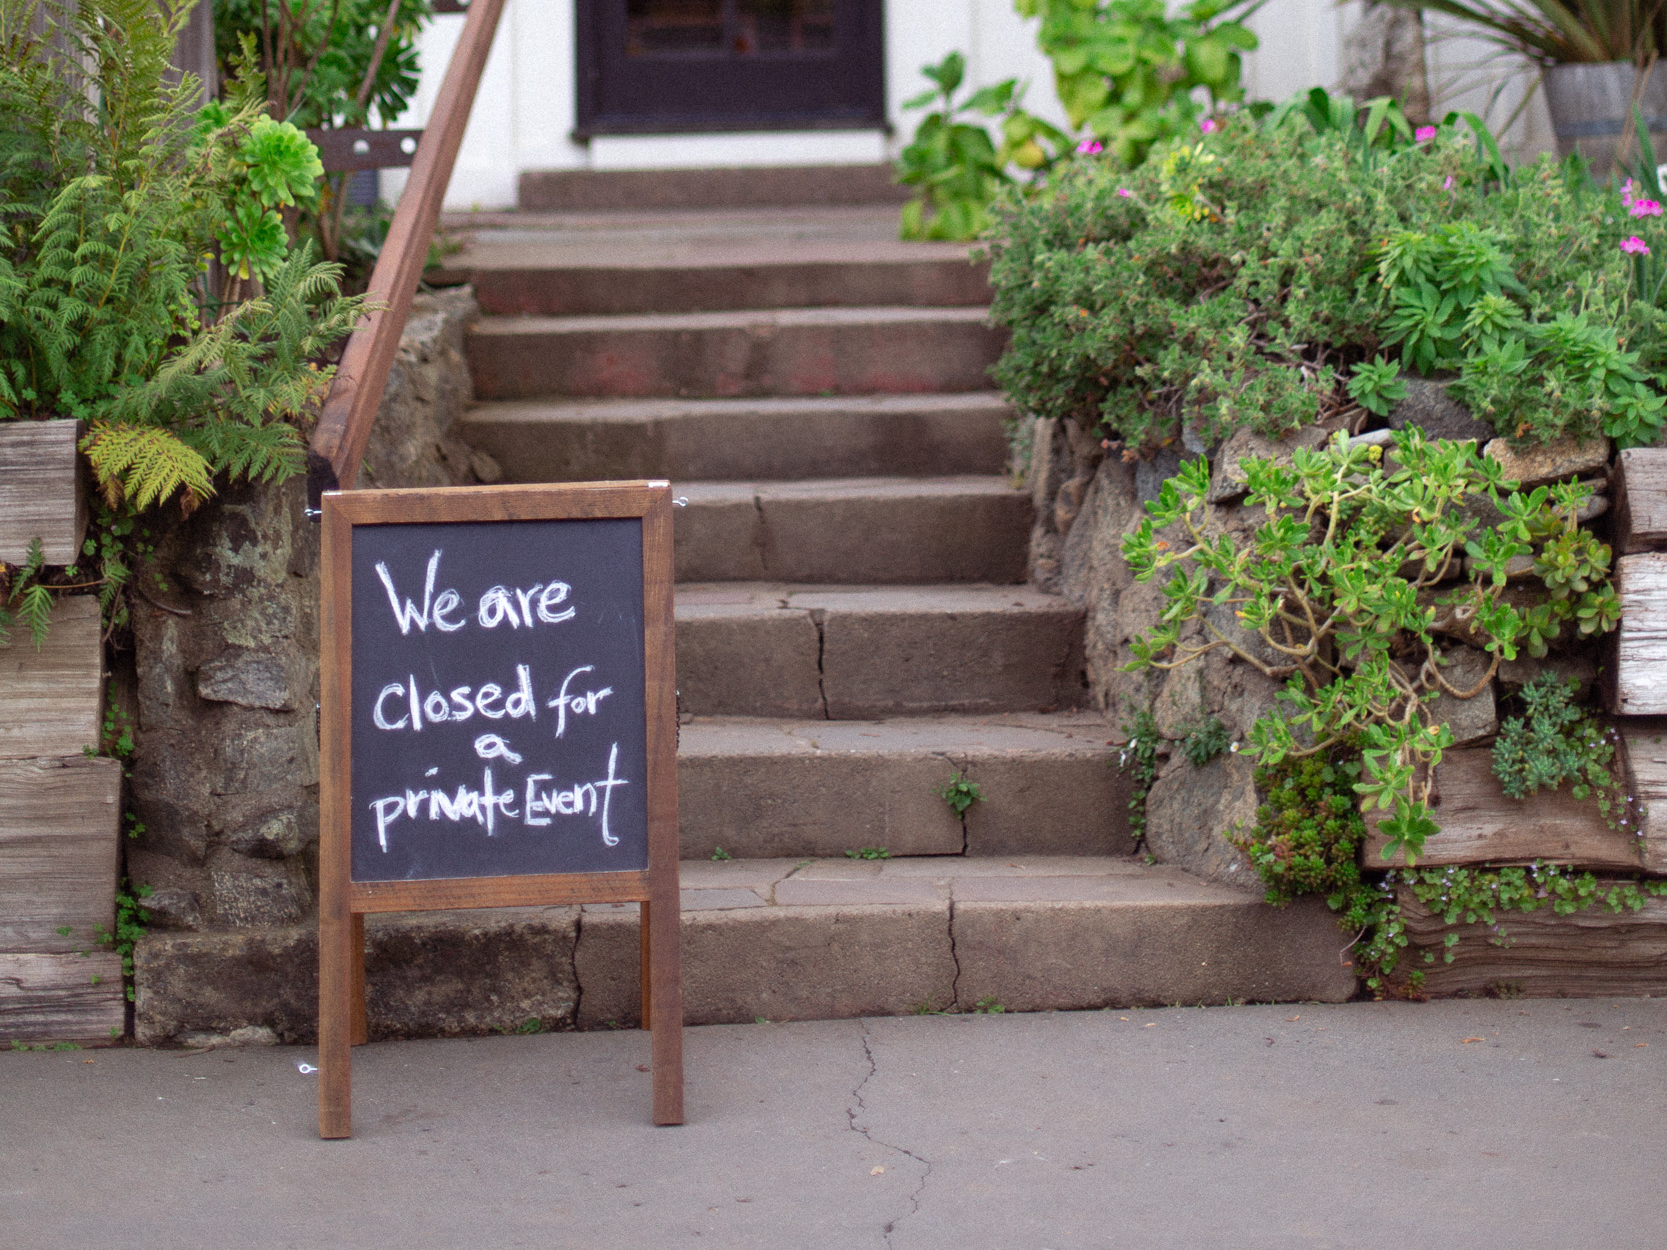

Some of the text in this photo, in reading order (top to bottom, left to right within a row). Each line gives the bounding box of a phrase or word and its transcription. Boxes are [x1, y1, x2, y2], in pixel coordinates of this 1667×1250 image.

[375, 549, 576, 636] We are
[547, 664, 614, 738] for
[474, 733, 523, 764] a
[369, 741, 630, 853] private Event
